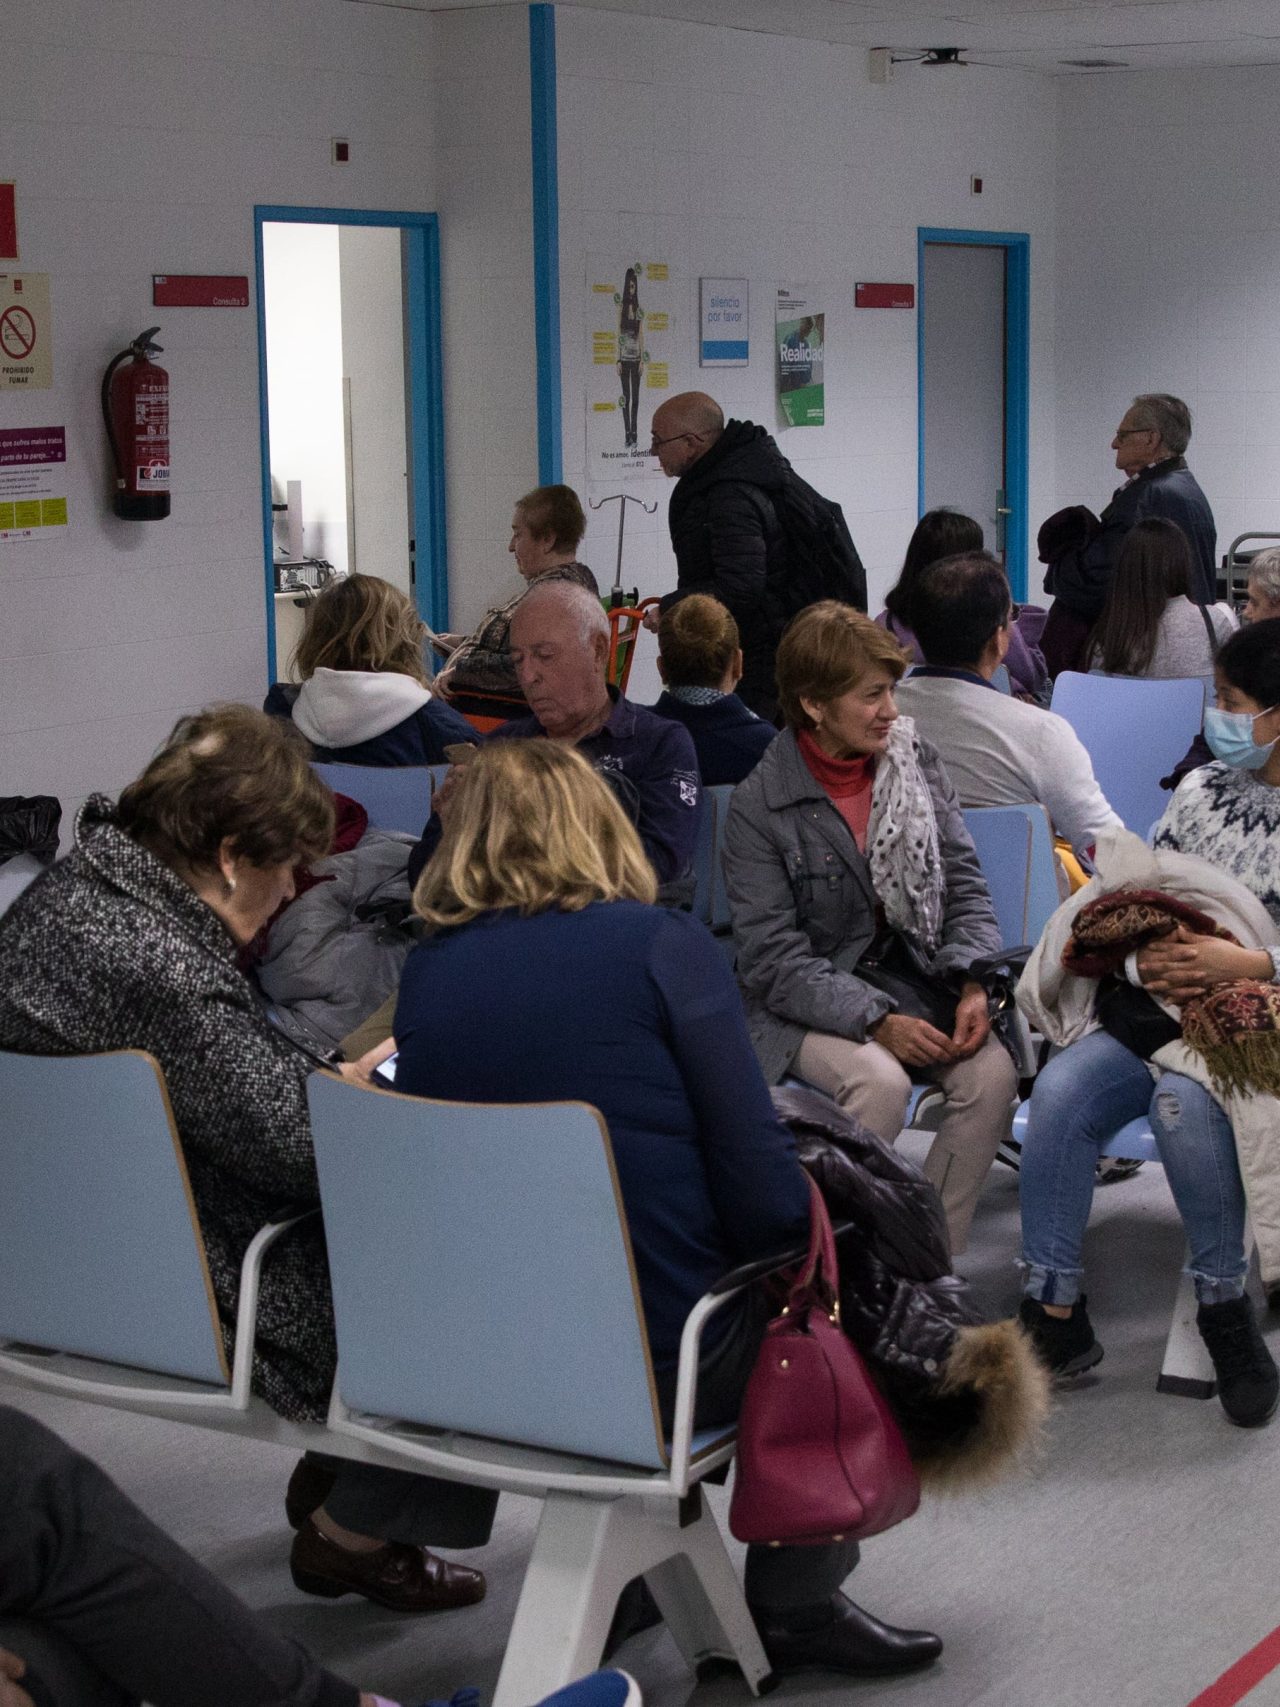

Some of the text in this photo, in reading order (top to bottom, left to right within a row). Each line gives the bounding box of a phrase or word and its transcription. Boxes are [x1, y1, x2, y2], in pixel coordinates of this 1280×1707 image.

[213, 297, 246, 305] Consulta 2
[710, 295, 739, 308] silencio
[708, 311, 742, 323] por favor
[780, 343, 824, 362] Realidad
[2, 366, 34, 374] PROHIBIDO
[9, 376, 28, 384] FUMAR
[2, 441, 13, 449] que
[13, 439, 30, 447] sufres
[30, 438, 47, 446] malos
[0, 454, 14, 463] parte
[601, 451, 609, 459] No
